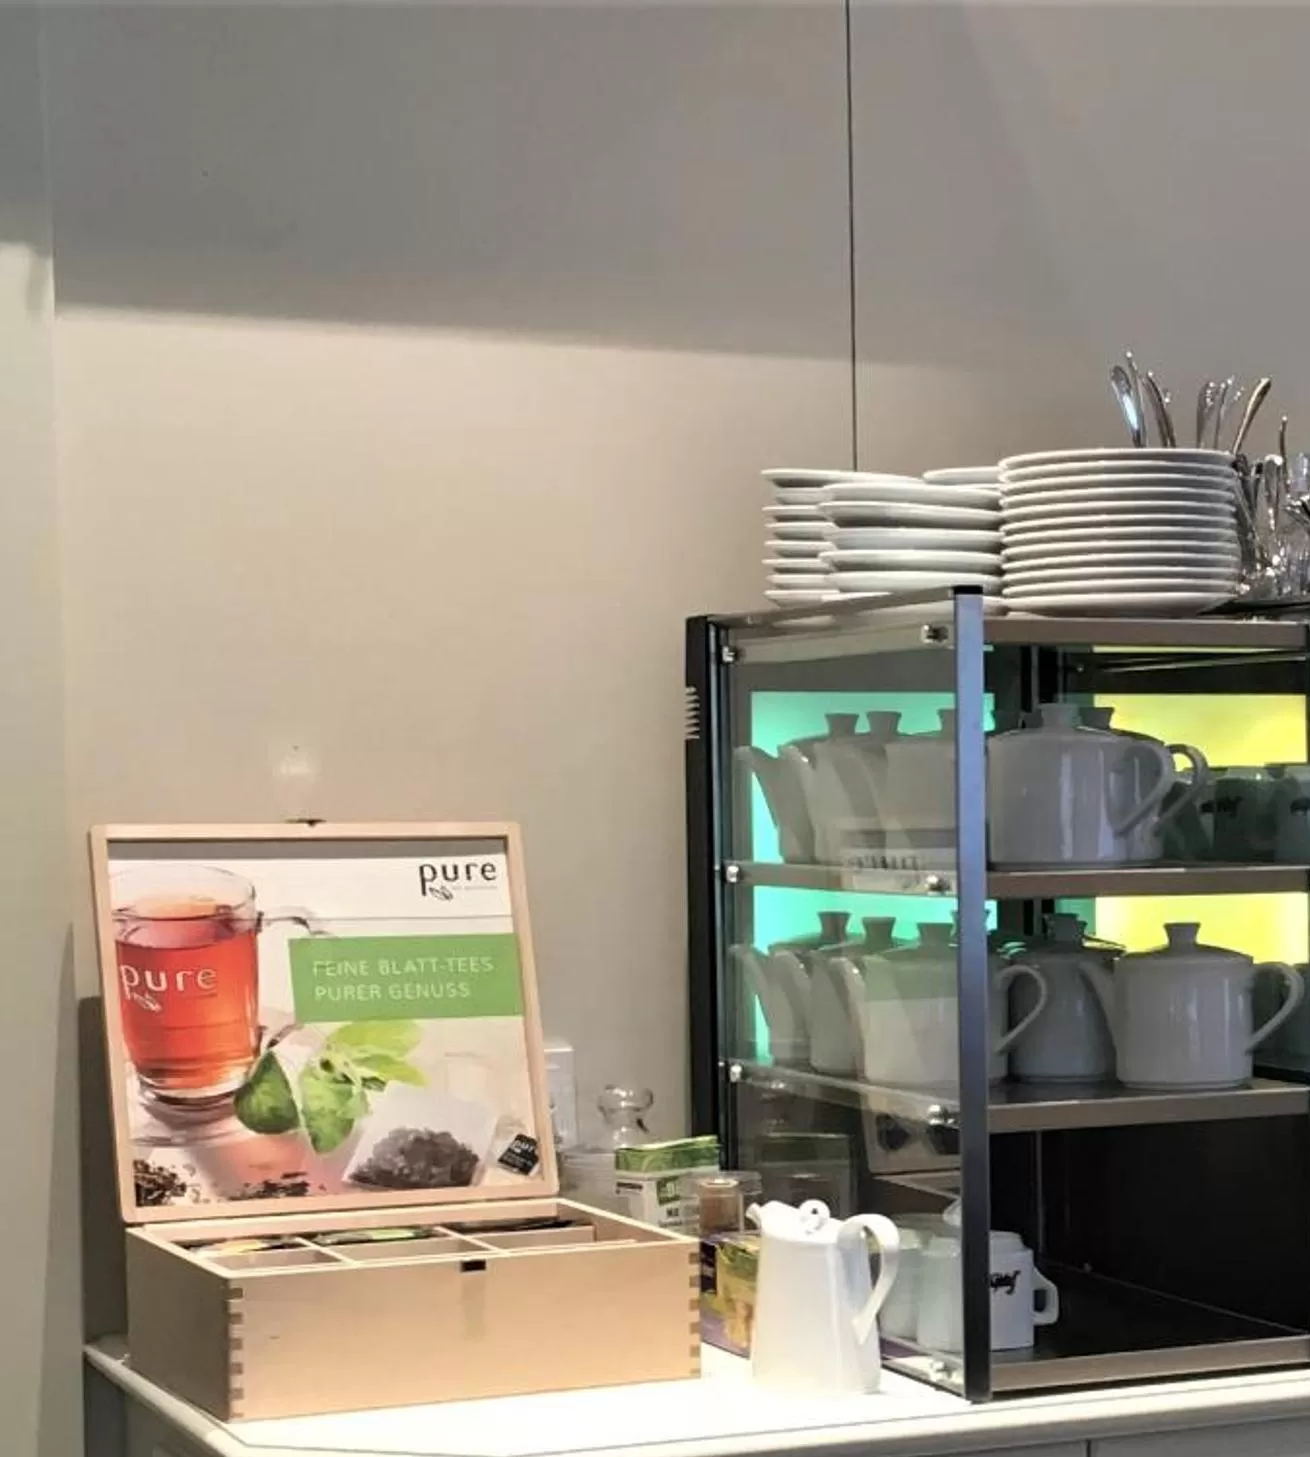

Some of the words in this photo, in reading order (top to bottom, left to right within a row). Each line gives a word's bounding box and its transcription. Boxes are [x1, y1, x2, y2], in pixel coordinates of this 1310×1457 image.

[418, 861, 497, 897] pure
[312, 959, 370, 977] FEINE
[378, 955, 495, 976] BLATT-TEES
[119, 964, 218, 1001] pure
[314, 983, 382, 1001] PURER
[387, 981, 471, 1000] GENUSS
